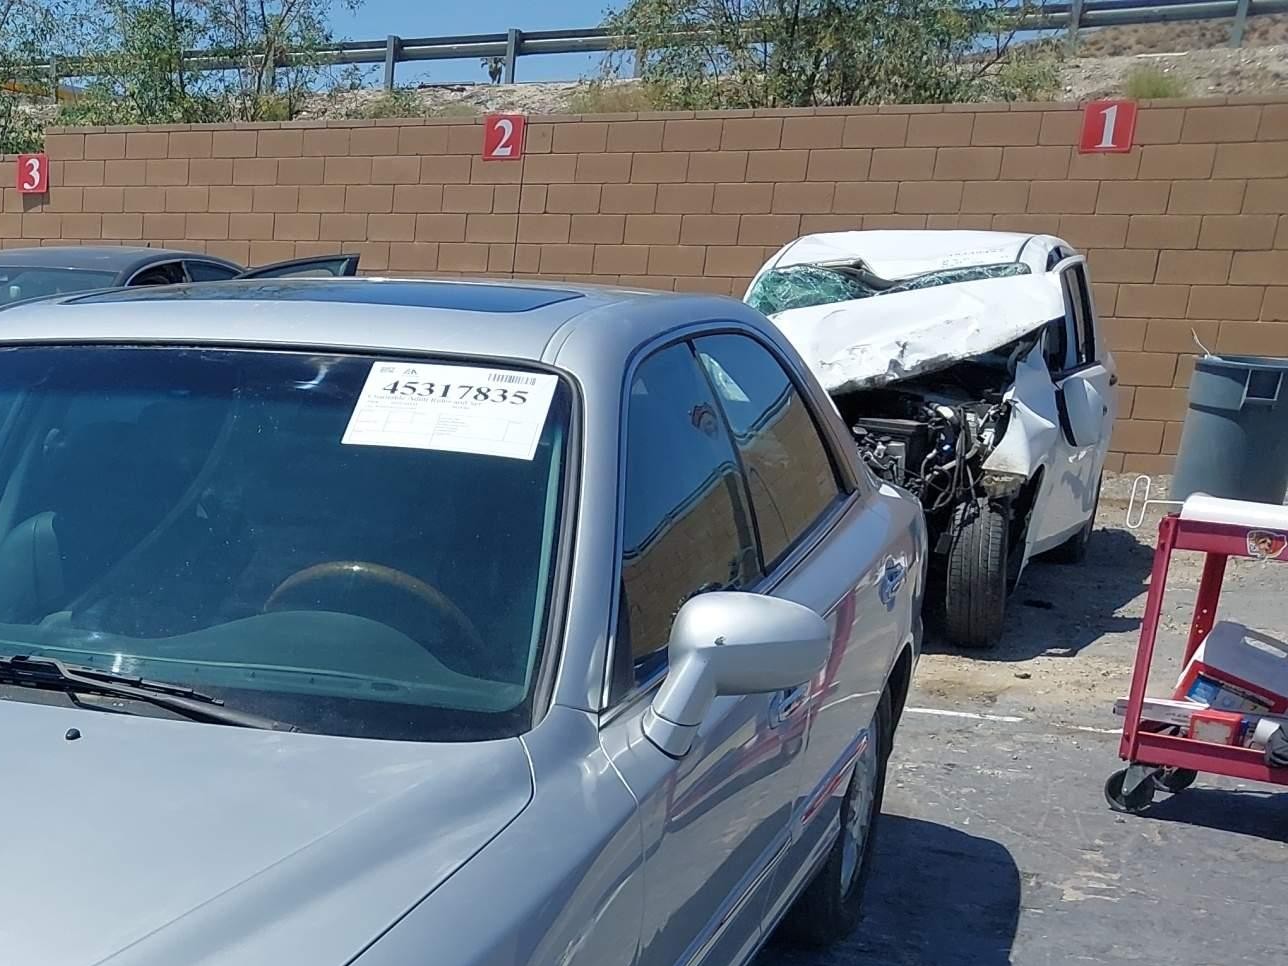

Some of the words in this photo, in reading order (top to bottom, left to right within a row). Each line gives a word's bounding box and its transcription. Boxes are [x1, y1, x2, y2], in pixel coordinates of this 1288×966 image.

[492, 119, 513, 155] 2
[1094, 105, 1118, 148] 1
[24, 158, 40, 189] 3
[383, 380, 529, 405] 45317835
